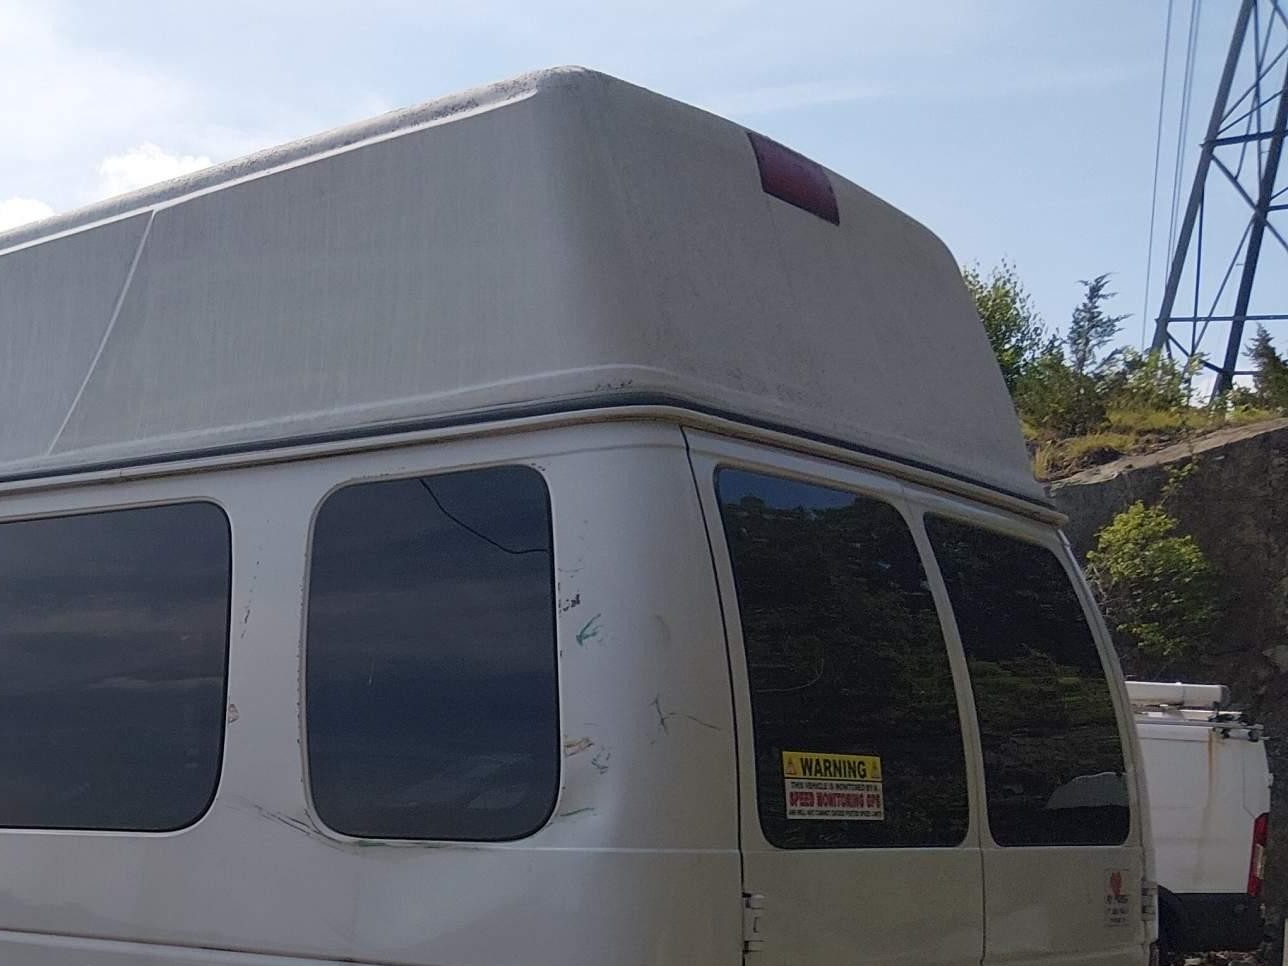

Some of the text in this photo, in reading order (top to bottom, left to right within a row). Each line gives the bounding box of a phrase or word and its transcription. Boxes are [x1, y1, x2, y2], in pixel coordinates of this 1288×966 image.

[799, 757, 867, 779] WARNING
[790, 791, 814, 807] SPEED
[816, 792, 864, 808] MONITORING
